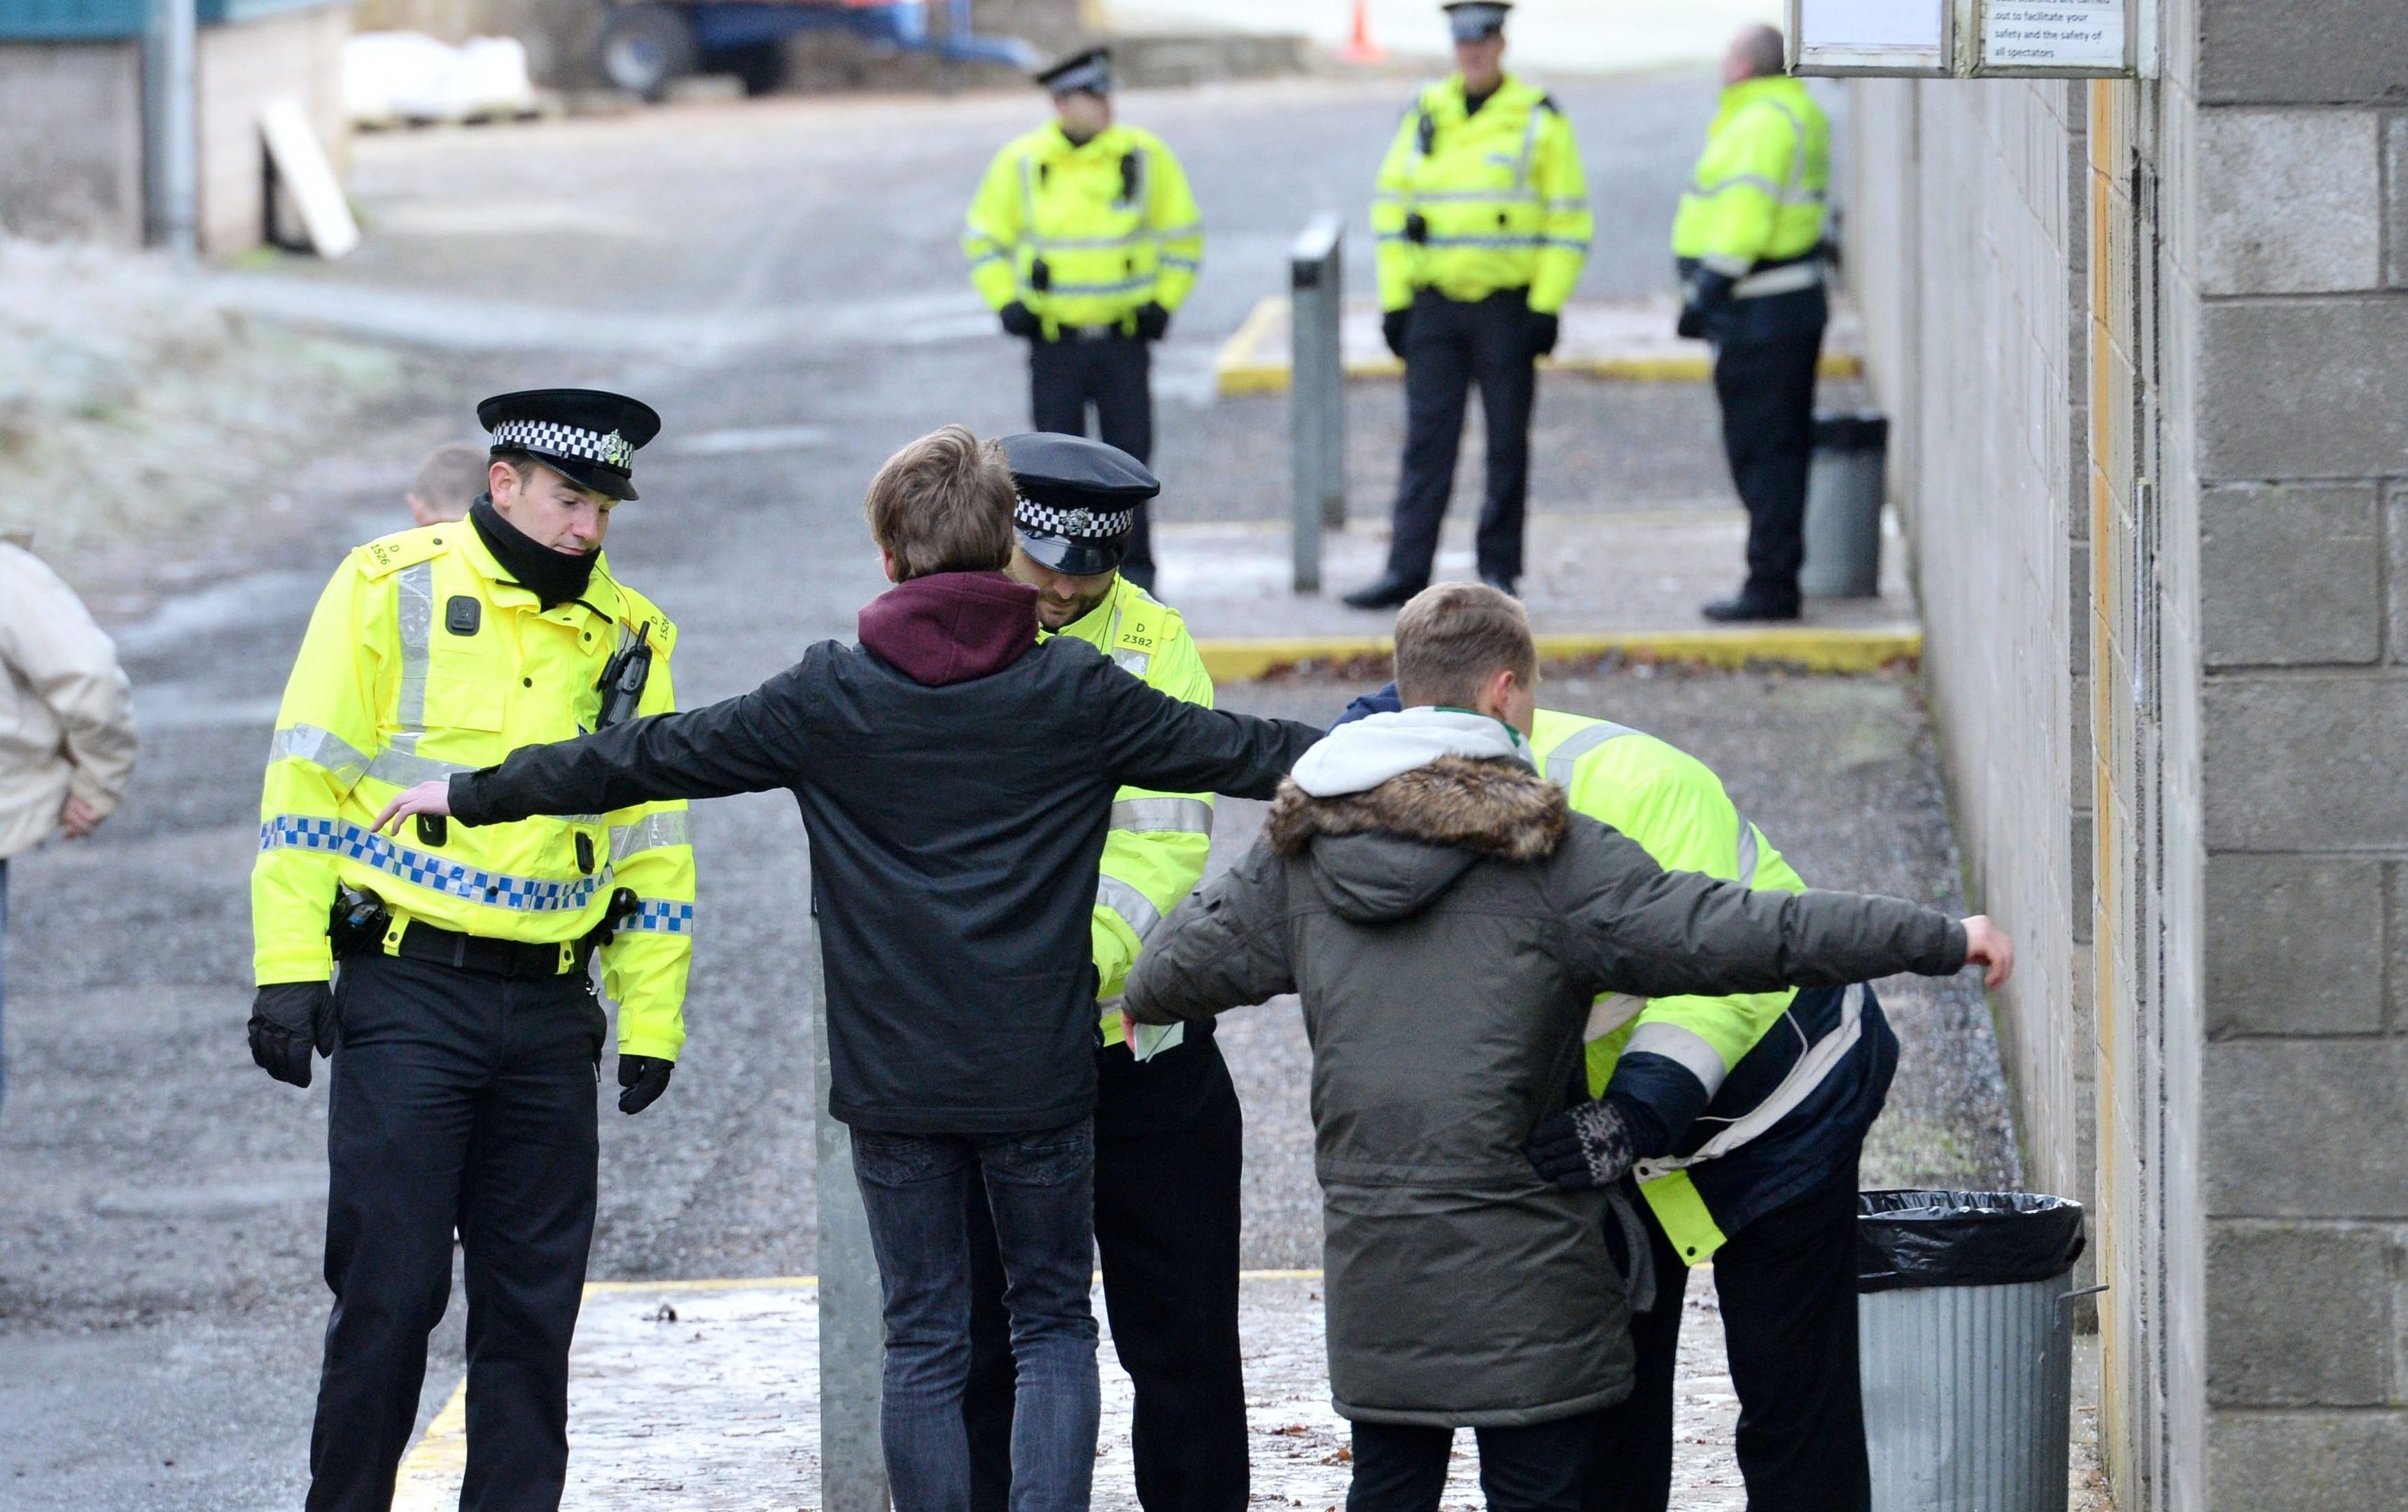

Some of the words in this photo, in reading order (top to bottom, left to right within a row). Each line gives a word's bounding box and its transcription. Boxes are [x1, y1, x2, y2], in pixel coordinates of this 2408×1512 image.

[2012, 12, 2022, 20] to
[2024, 10, 2064, 21] facilitate
[2065, 14, 2088, 23] your
[1995, 28, 2021, 40] safety
[2024, 30, 2040, 39] and
[2043, 30, 2057, 39] the
[2061, 30, 2089, 42] safety
[2091, 30, 2102, 40] of
[1995, 48, 2005, 56] all
[2008, 49, 2054, 58] spectators
[371, 544, 391, 565] 1526
[650, 616, 658, 625] D
[660, 617, 669, 641] 1526
[1136, 623, 1145, 633] D
[1122, 634, 1152, 648] 2382
